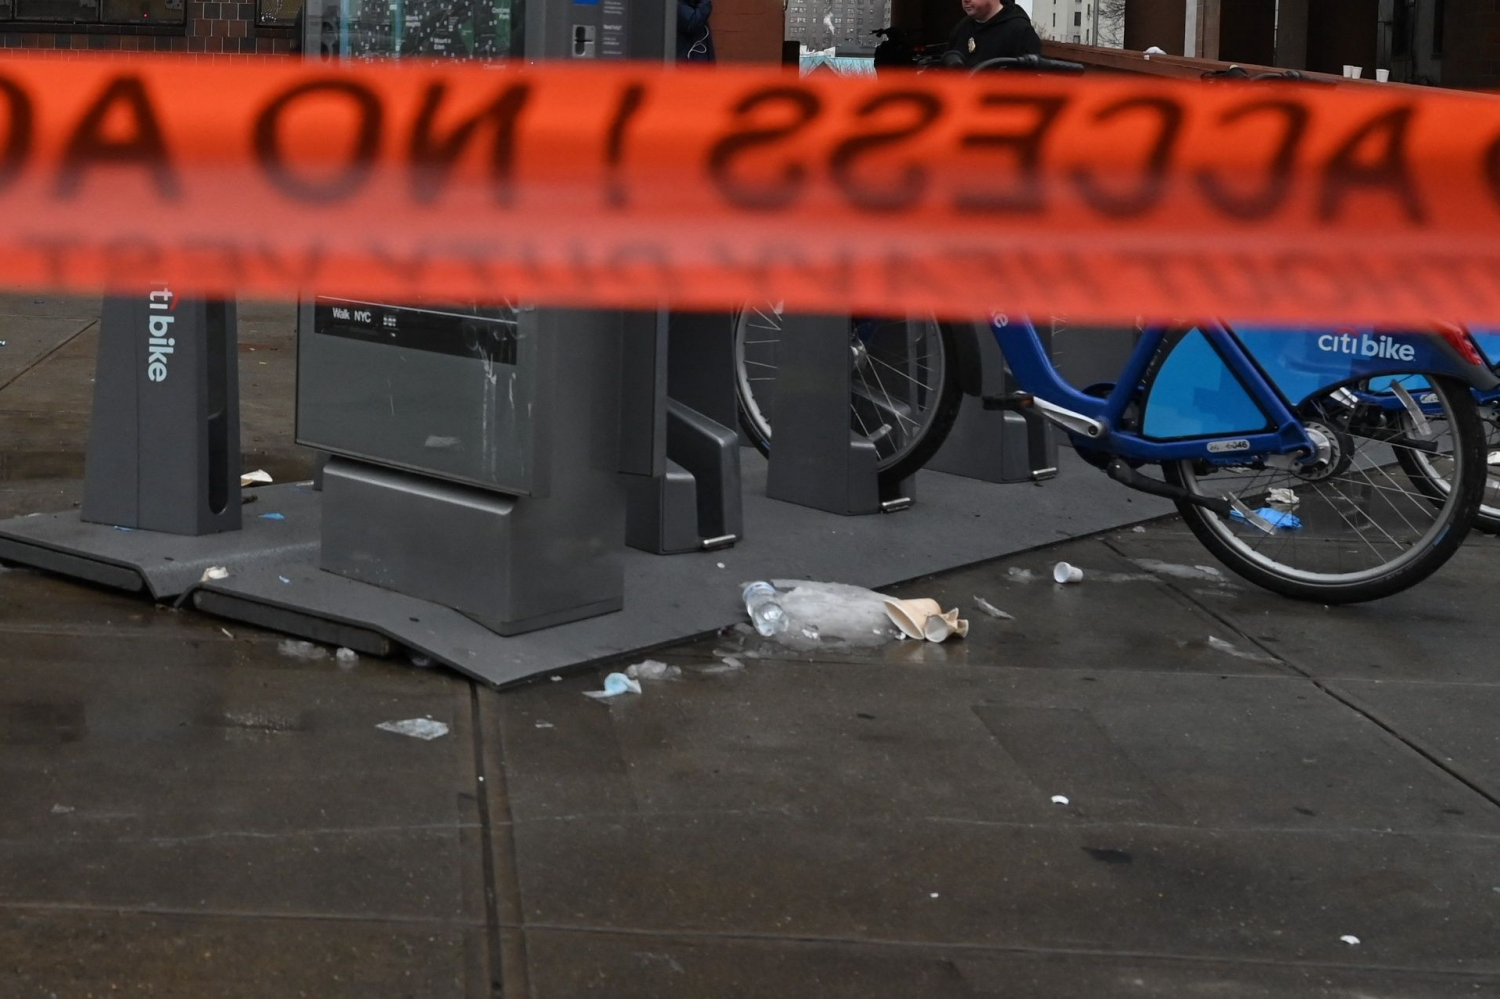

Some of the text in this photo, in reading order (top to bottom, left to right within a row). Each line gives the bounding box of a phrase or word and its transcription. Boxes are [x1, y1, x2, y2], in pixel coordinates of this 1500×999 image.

[332, 307, 371, 323] Walk NYC
[147, 315, 176, 382] bike
[1318, 332, 1415, 361] citi bike
